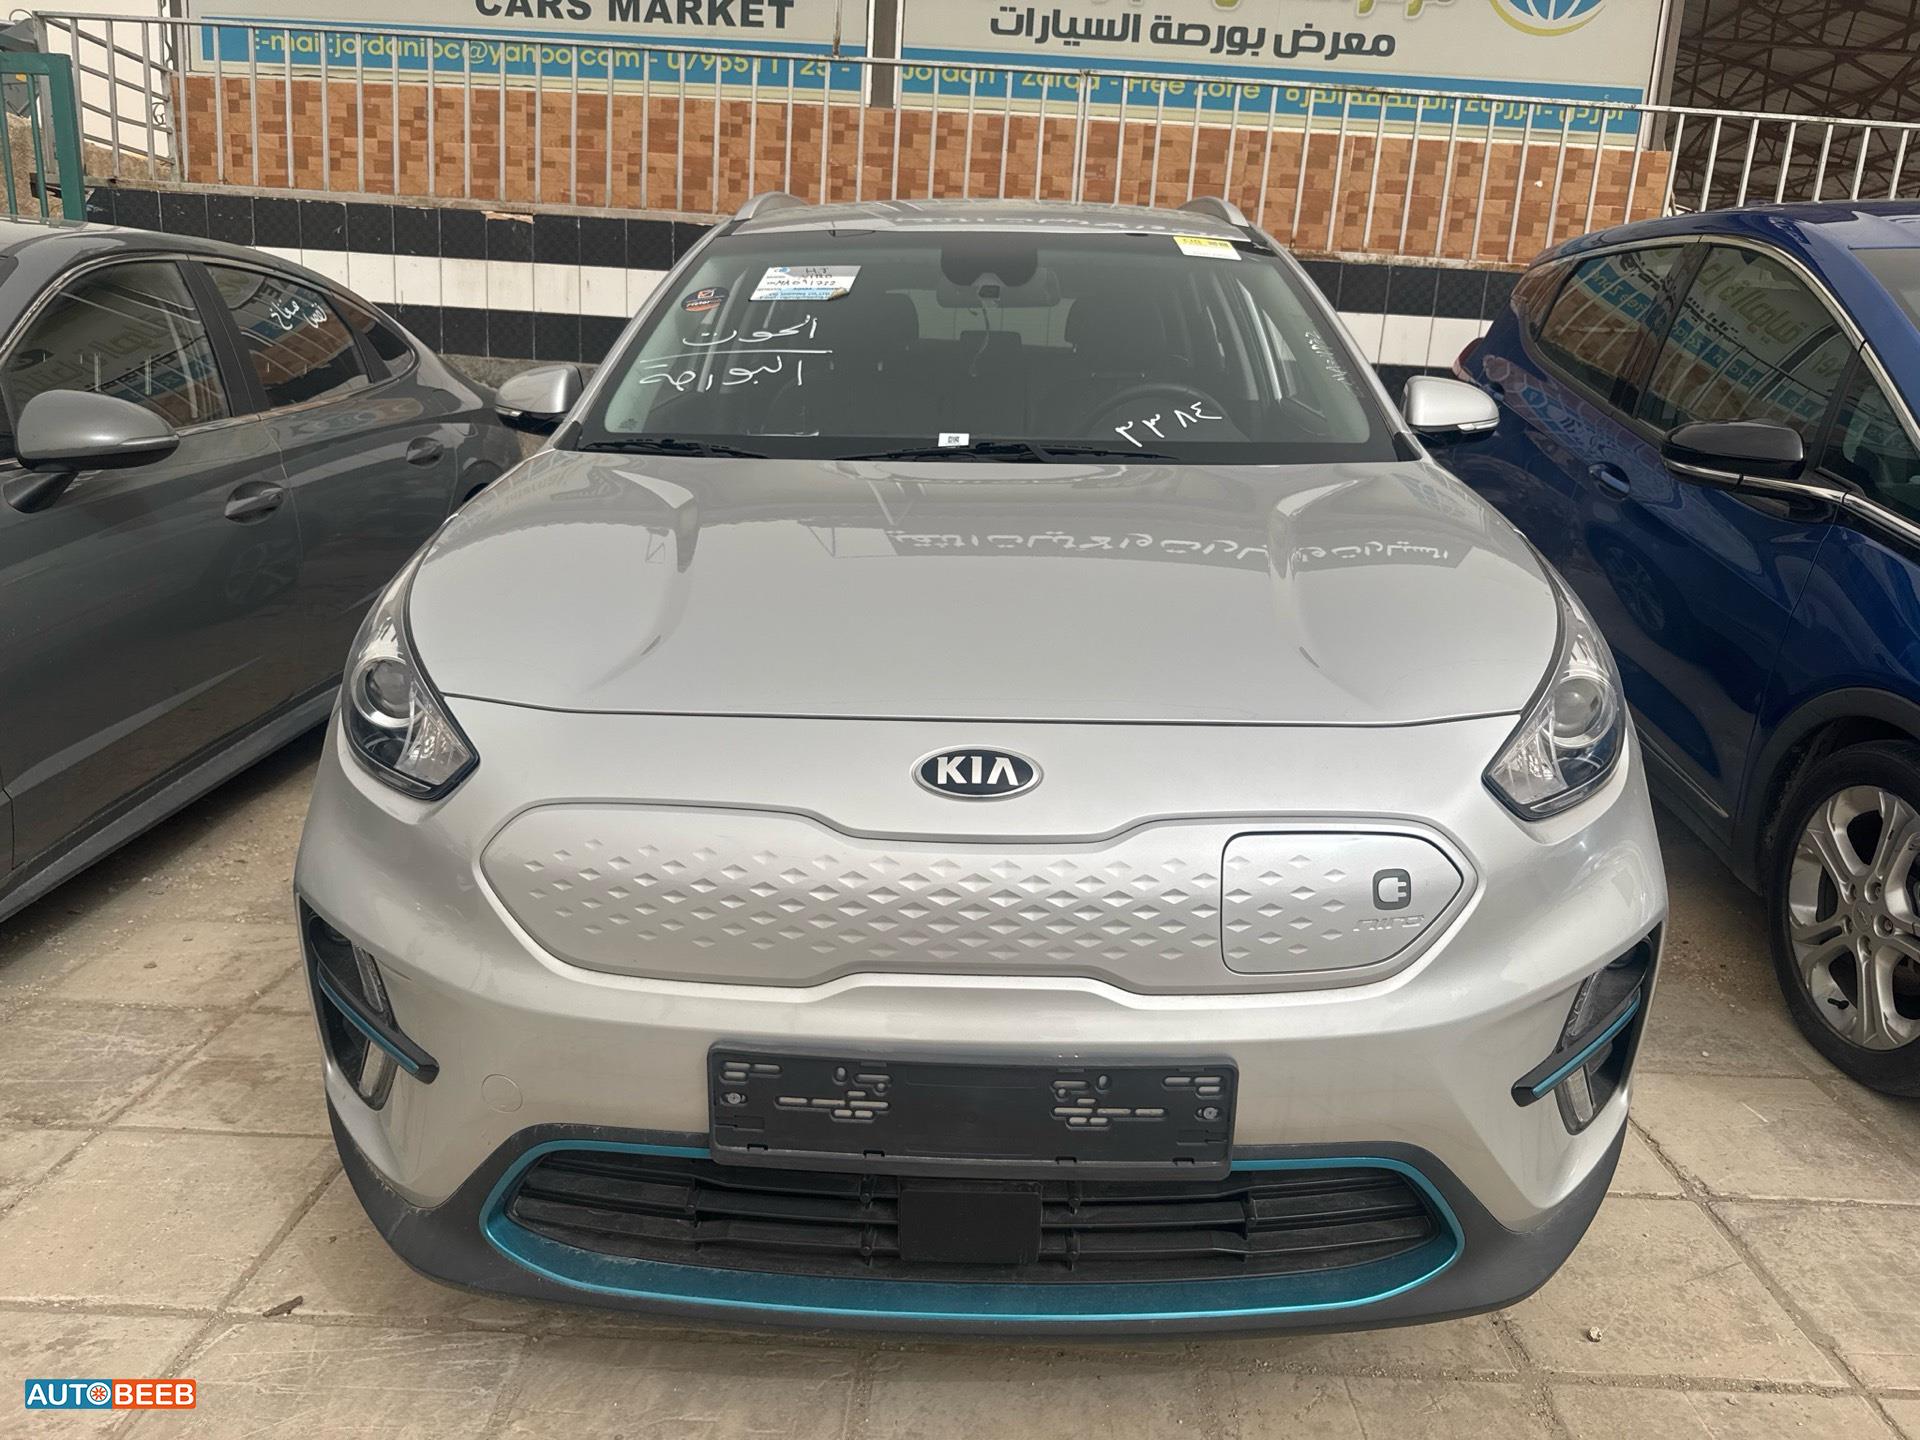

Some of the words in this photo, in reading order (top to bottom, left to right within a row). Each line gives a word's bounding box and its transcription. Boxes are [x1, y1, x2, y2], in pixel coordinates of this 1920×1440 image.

[475, 0, 592, 20] CARS
[608, 0, 795, 29] MARKET
[990, 6, 1141, 46] السيارات
[1150, 15, 1266, 56] بورصة
[1273, 23, 1396, 60] معرض
[936, 756, 1019, 786] KIA
